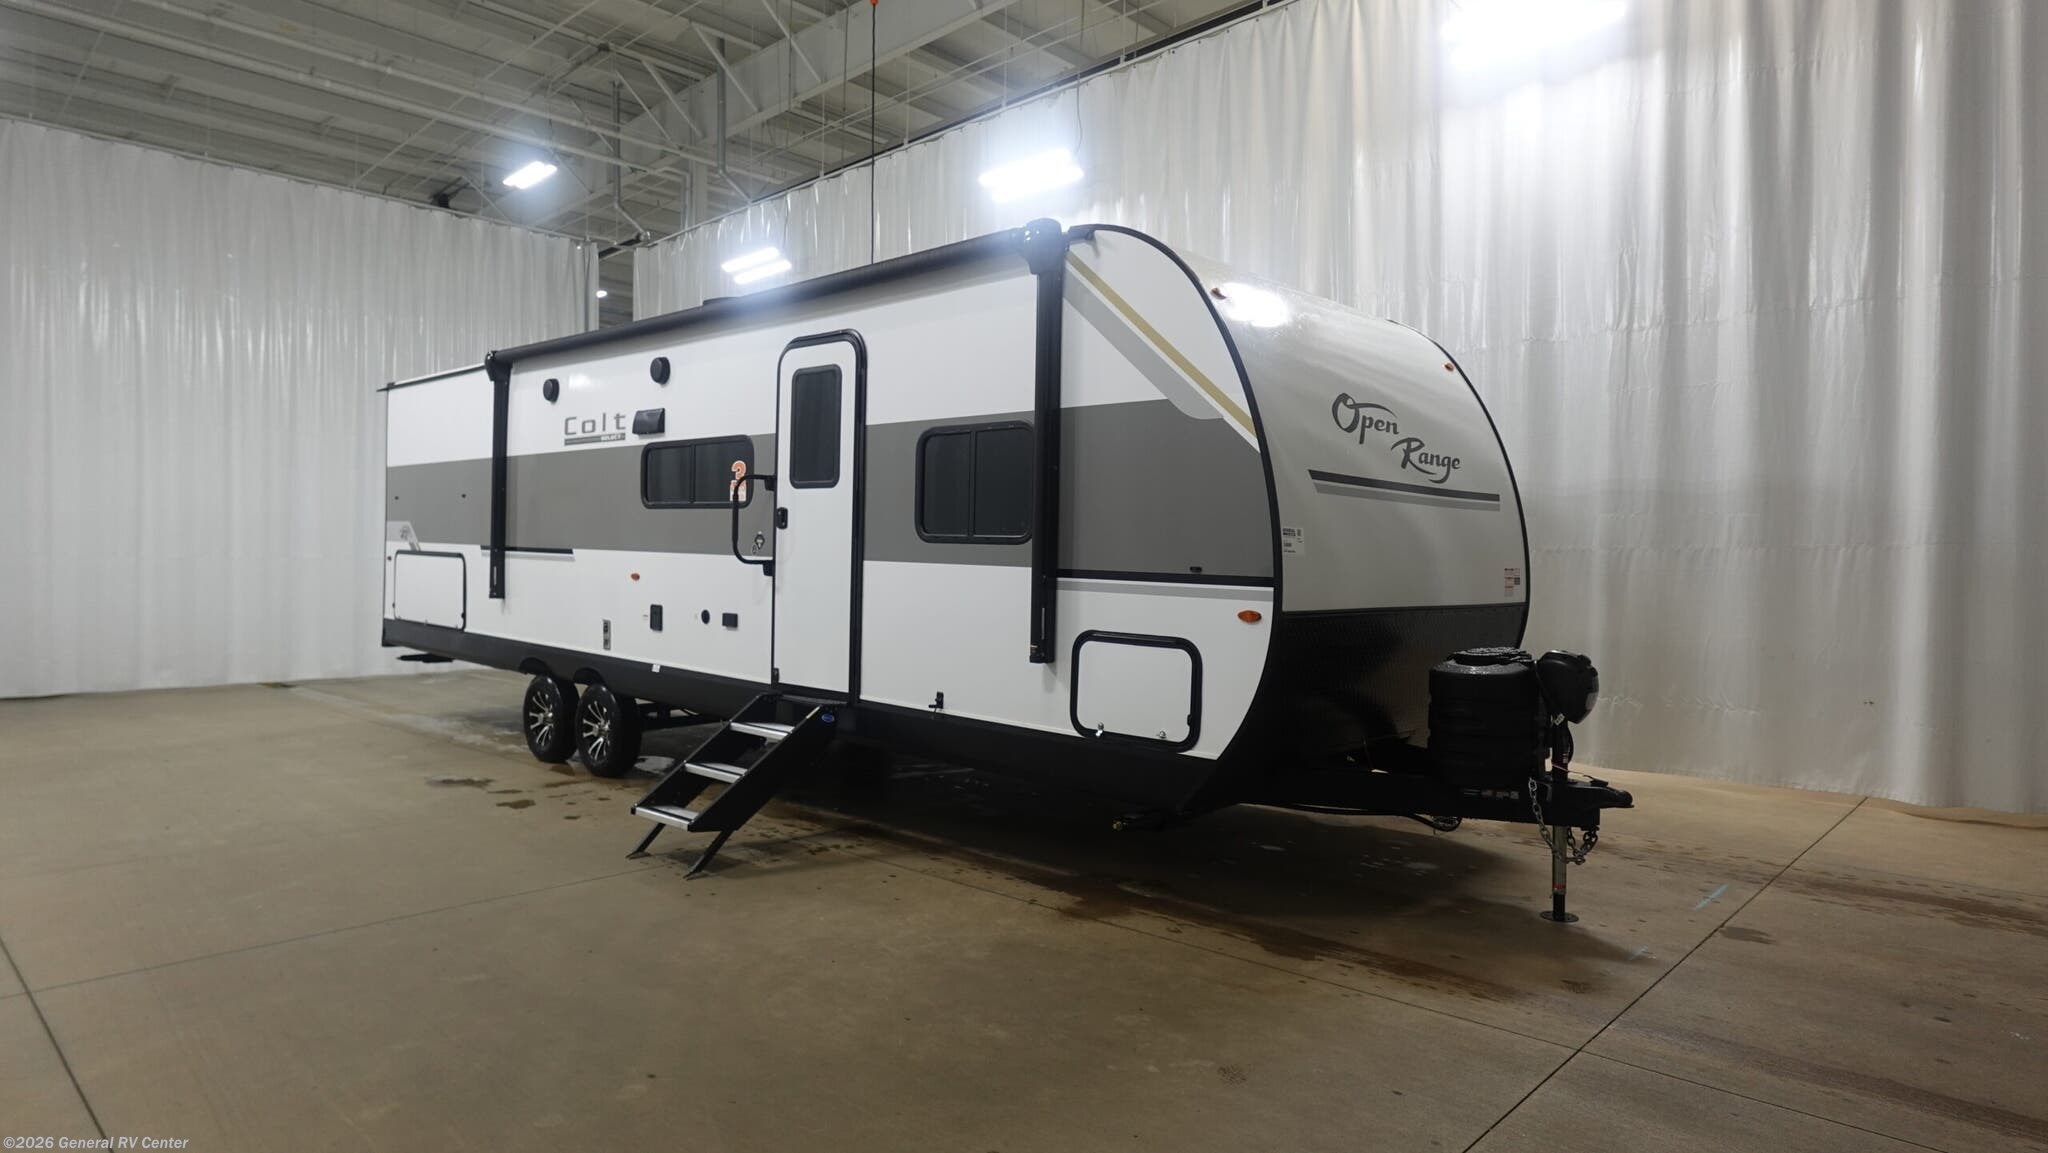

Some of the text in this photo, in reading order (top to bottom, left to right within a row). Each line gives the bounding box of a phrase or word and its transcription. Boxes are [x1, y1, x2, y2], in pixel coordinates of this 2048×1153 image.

[564, 412, 626, 436] Colt
[1332, 392, 1399, 445] Open
[1390, 437, 1461, 484] Range
